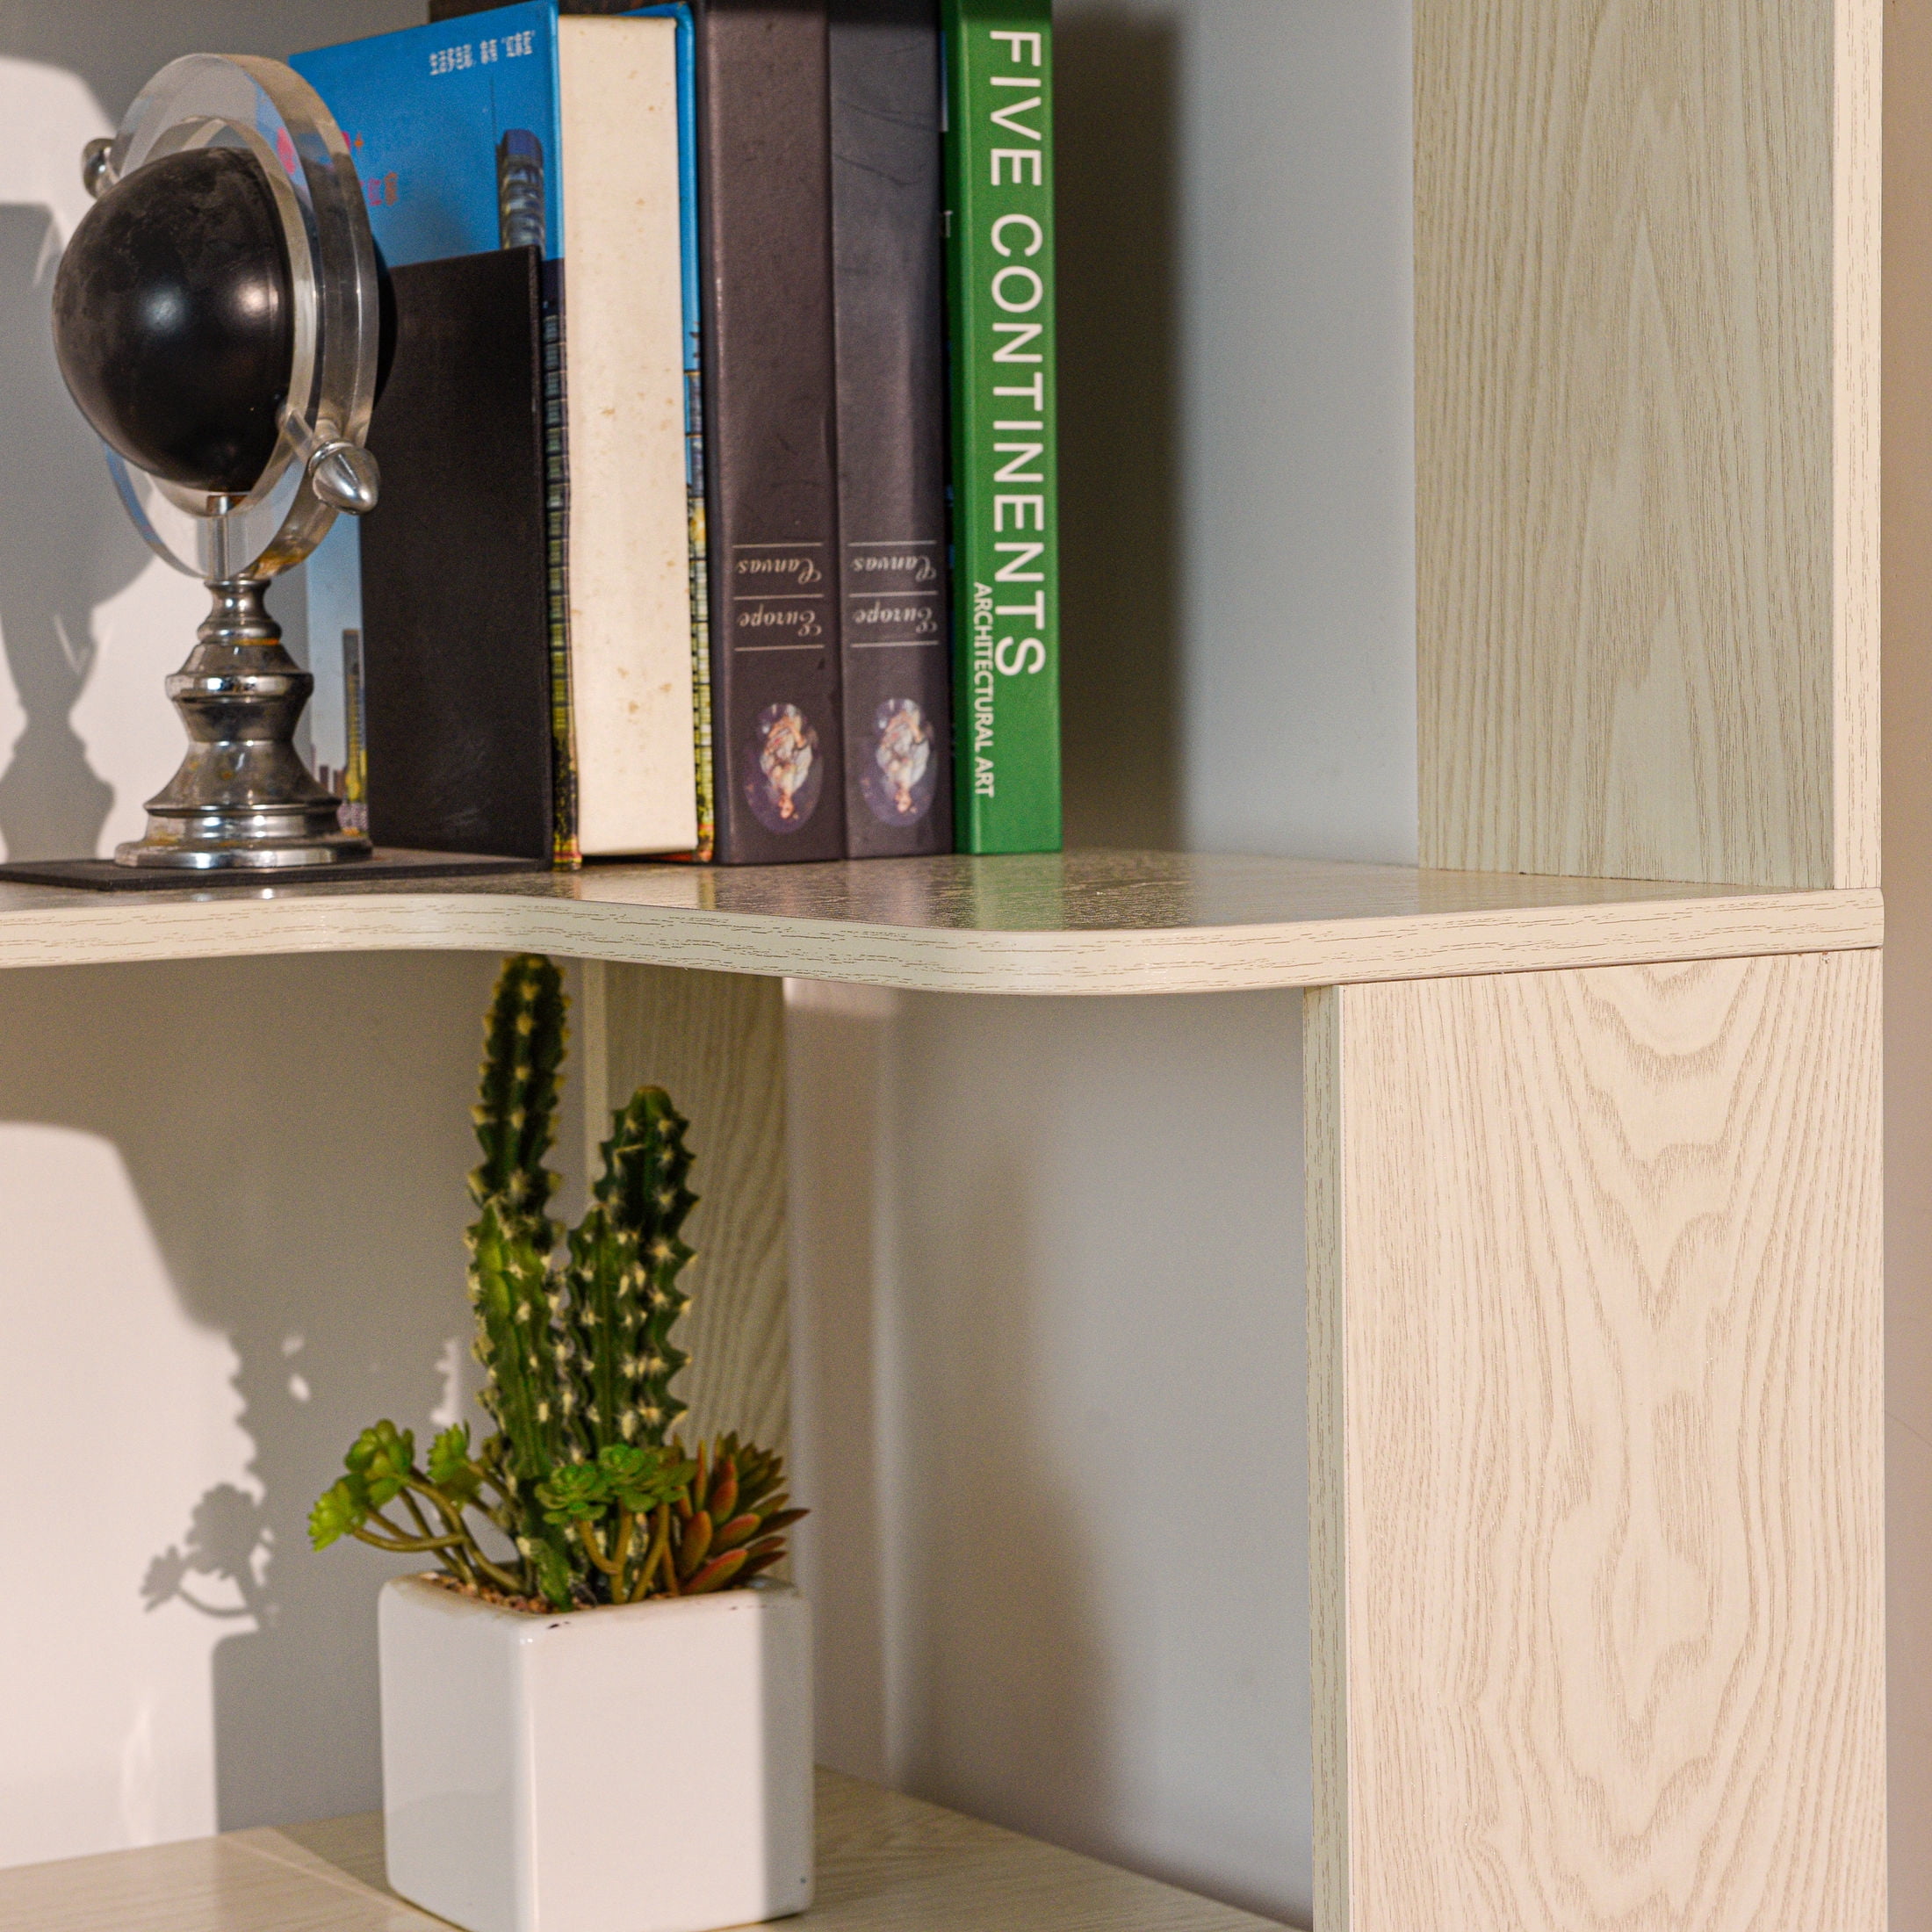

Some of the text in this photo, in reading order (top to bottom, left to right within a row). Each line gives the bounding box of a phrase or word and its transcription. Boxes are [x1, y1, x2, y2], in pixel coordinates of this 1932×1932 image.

[990, 31, 1046, 676] FIVE CONTINENTS
[737, 557, 823, 585] Canvas
[852, 554, 937, 582] Canvas
[738, 603, 823, 637] Europe
[854, 599, 938, 633] Europe
[973, 581, 994, 798] ARCHITECTURAL ART
